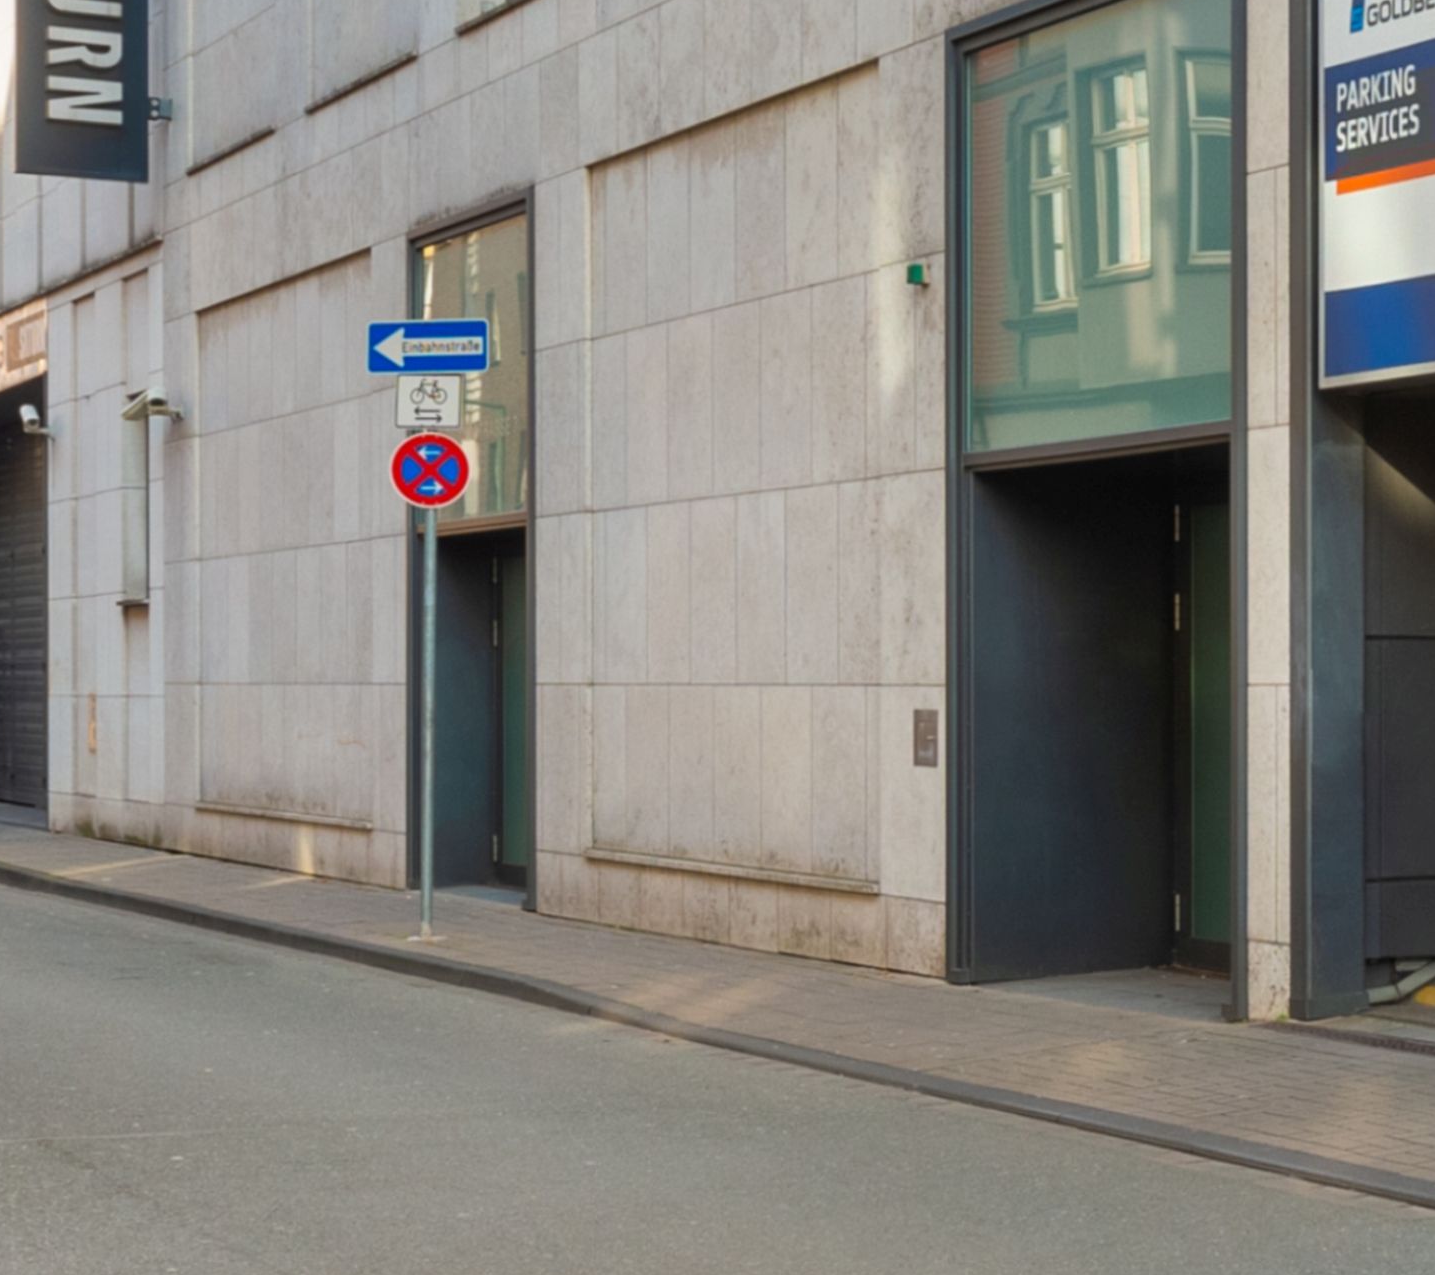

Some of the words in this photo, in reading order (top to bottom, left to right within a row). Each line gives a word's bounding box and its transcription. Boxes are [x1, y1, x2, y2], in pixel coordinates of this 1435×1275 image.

[1336, 64, 1416, 113] PARKING
[1335, 103, 1420, 153] SERVICES
[402, 336, 481, 355] Einbahnstraße
